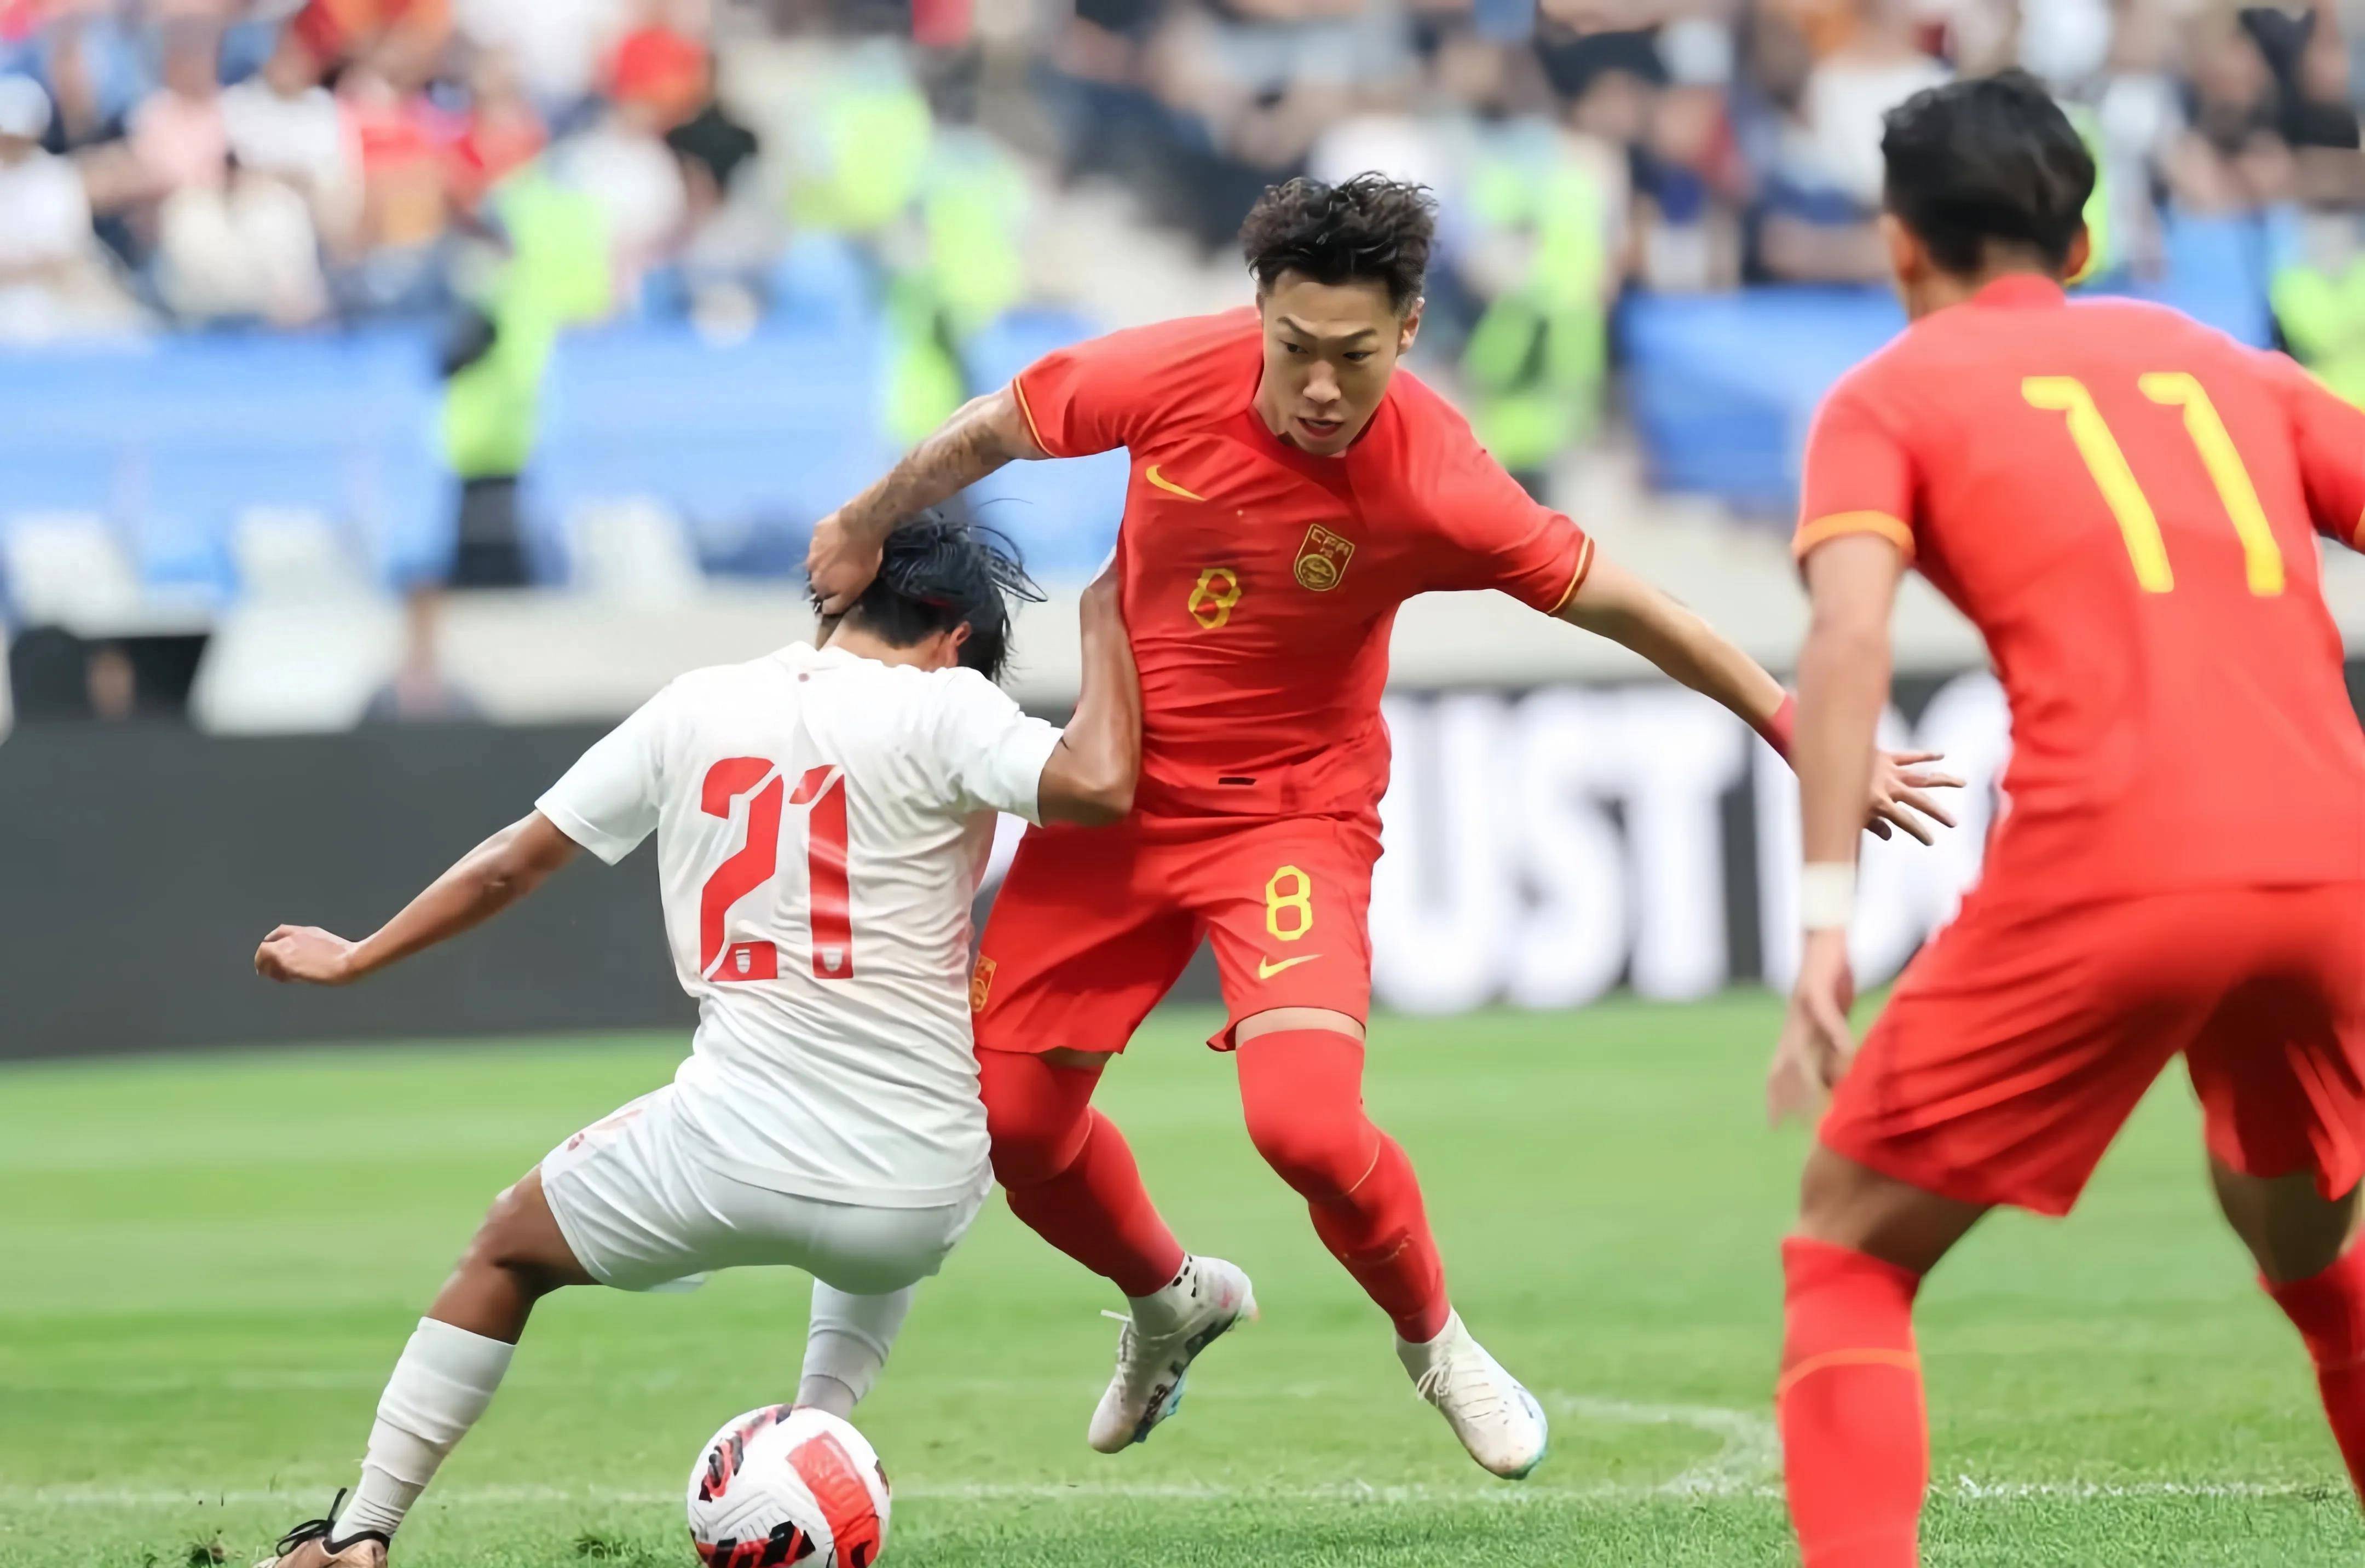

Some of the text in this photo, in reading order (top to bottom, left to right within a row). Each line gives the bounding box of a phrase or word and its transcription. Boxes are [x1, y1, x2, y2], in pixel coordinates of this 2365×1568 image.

[2021, 372, 2285, 597] 11
[1188, 568, 1242, 629] 8
[701, 756, 853, 982] 21
[1265, 864, 1313, 941] 8
